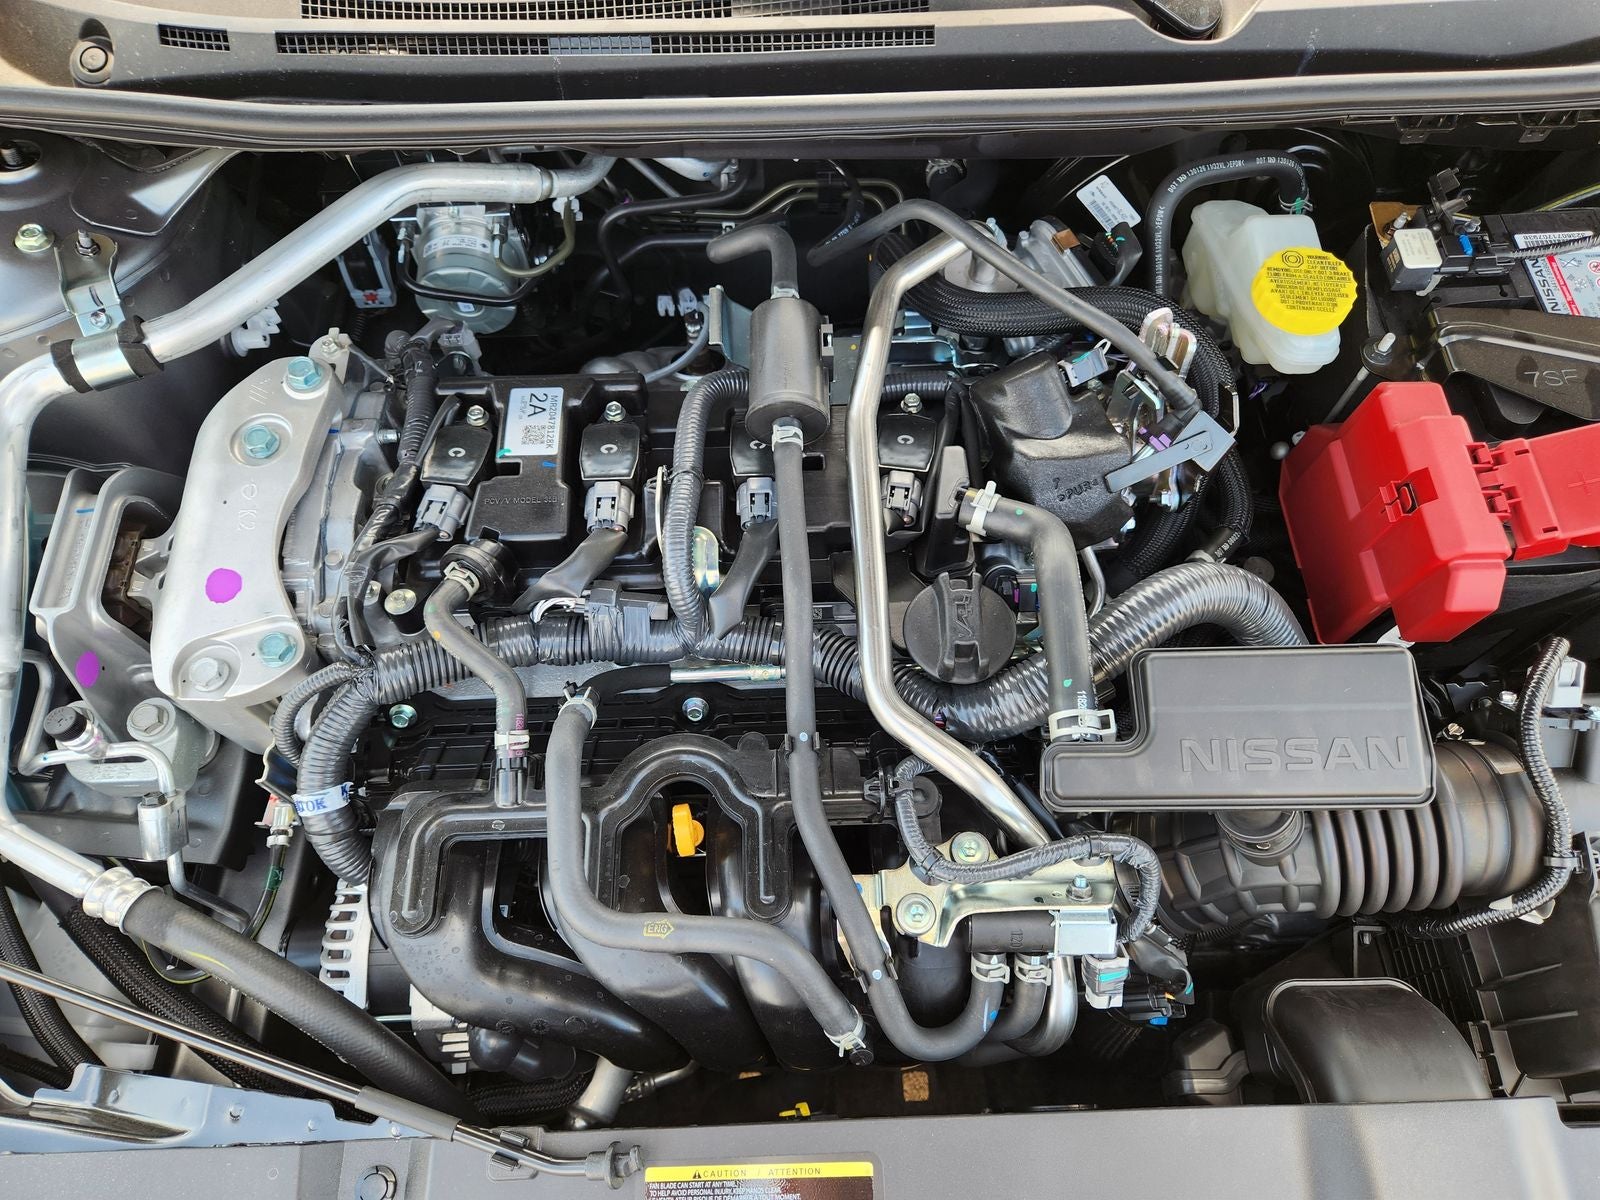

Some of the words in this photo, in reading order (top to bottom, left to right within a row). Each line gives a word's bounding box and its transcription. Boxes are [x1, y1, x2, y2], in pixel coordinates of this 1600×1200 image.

[1529, 257, 1561, 312] NISSAN
[1524, 369, 1577, 387] 7SF
[527, 393, 549, 418] 2A
[513, 496, 541, 504] MODEL
[1180, 736, 1409, 773] NISSAN
[647, 923, 668, 934] ENG
[703, 1169, 747, 1178] CAUTION
[768, 1167, 821, 1176] ATTENTION
[688, 1188, 713, 1196] PERSONAL
